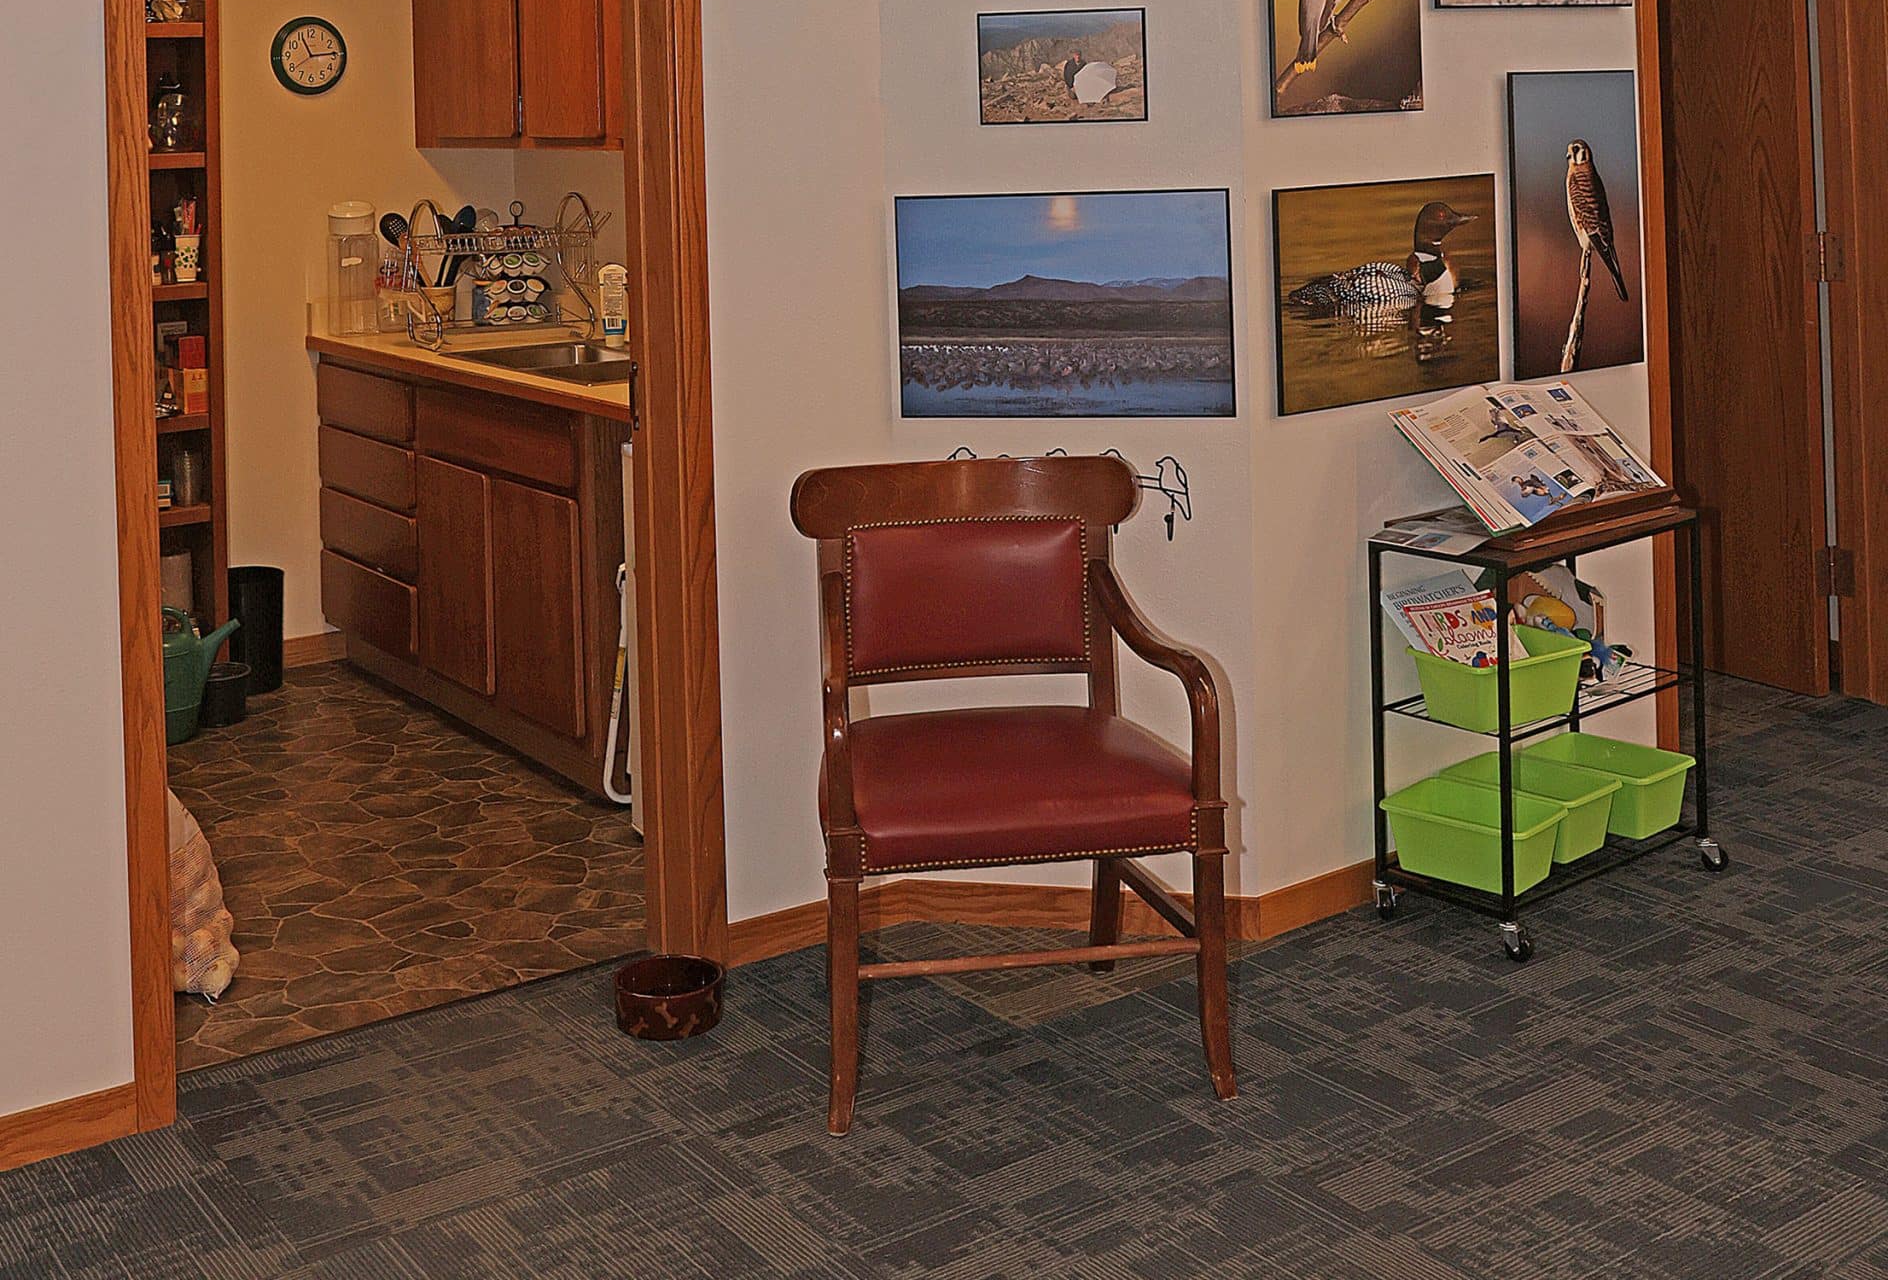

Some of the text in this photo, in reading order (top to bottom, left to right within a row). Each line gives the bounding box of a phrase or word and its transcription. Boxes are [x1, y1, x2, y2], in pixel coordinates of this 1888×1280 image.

[306, 28, 315, 38] 12
[288, 40, 298, 50] 10
[326, 39, 333, 49] 2
[284, 51, 291, 61] 9
[288, 63, 295, 72] 8
[326, 63, 333, 71] 4
[298, 71, 304, 80] 7
[308, 73, 315, 83] 6
[319, 70, 325, 80] 5
[1386, 585, 1426, 600] BEGINNING
